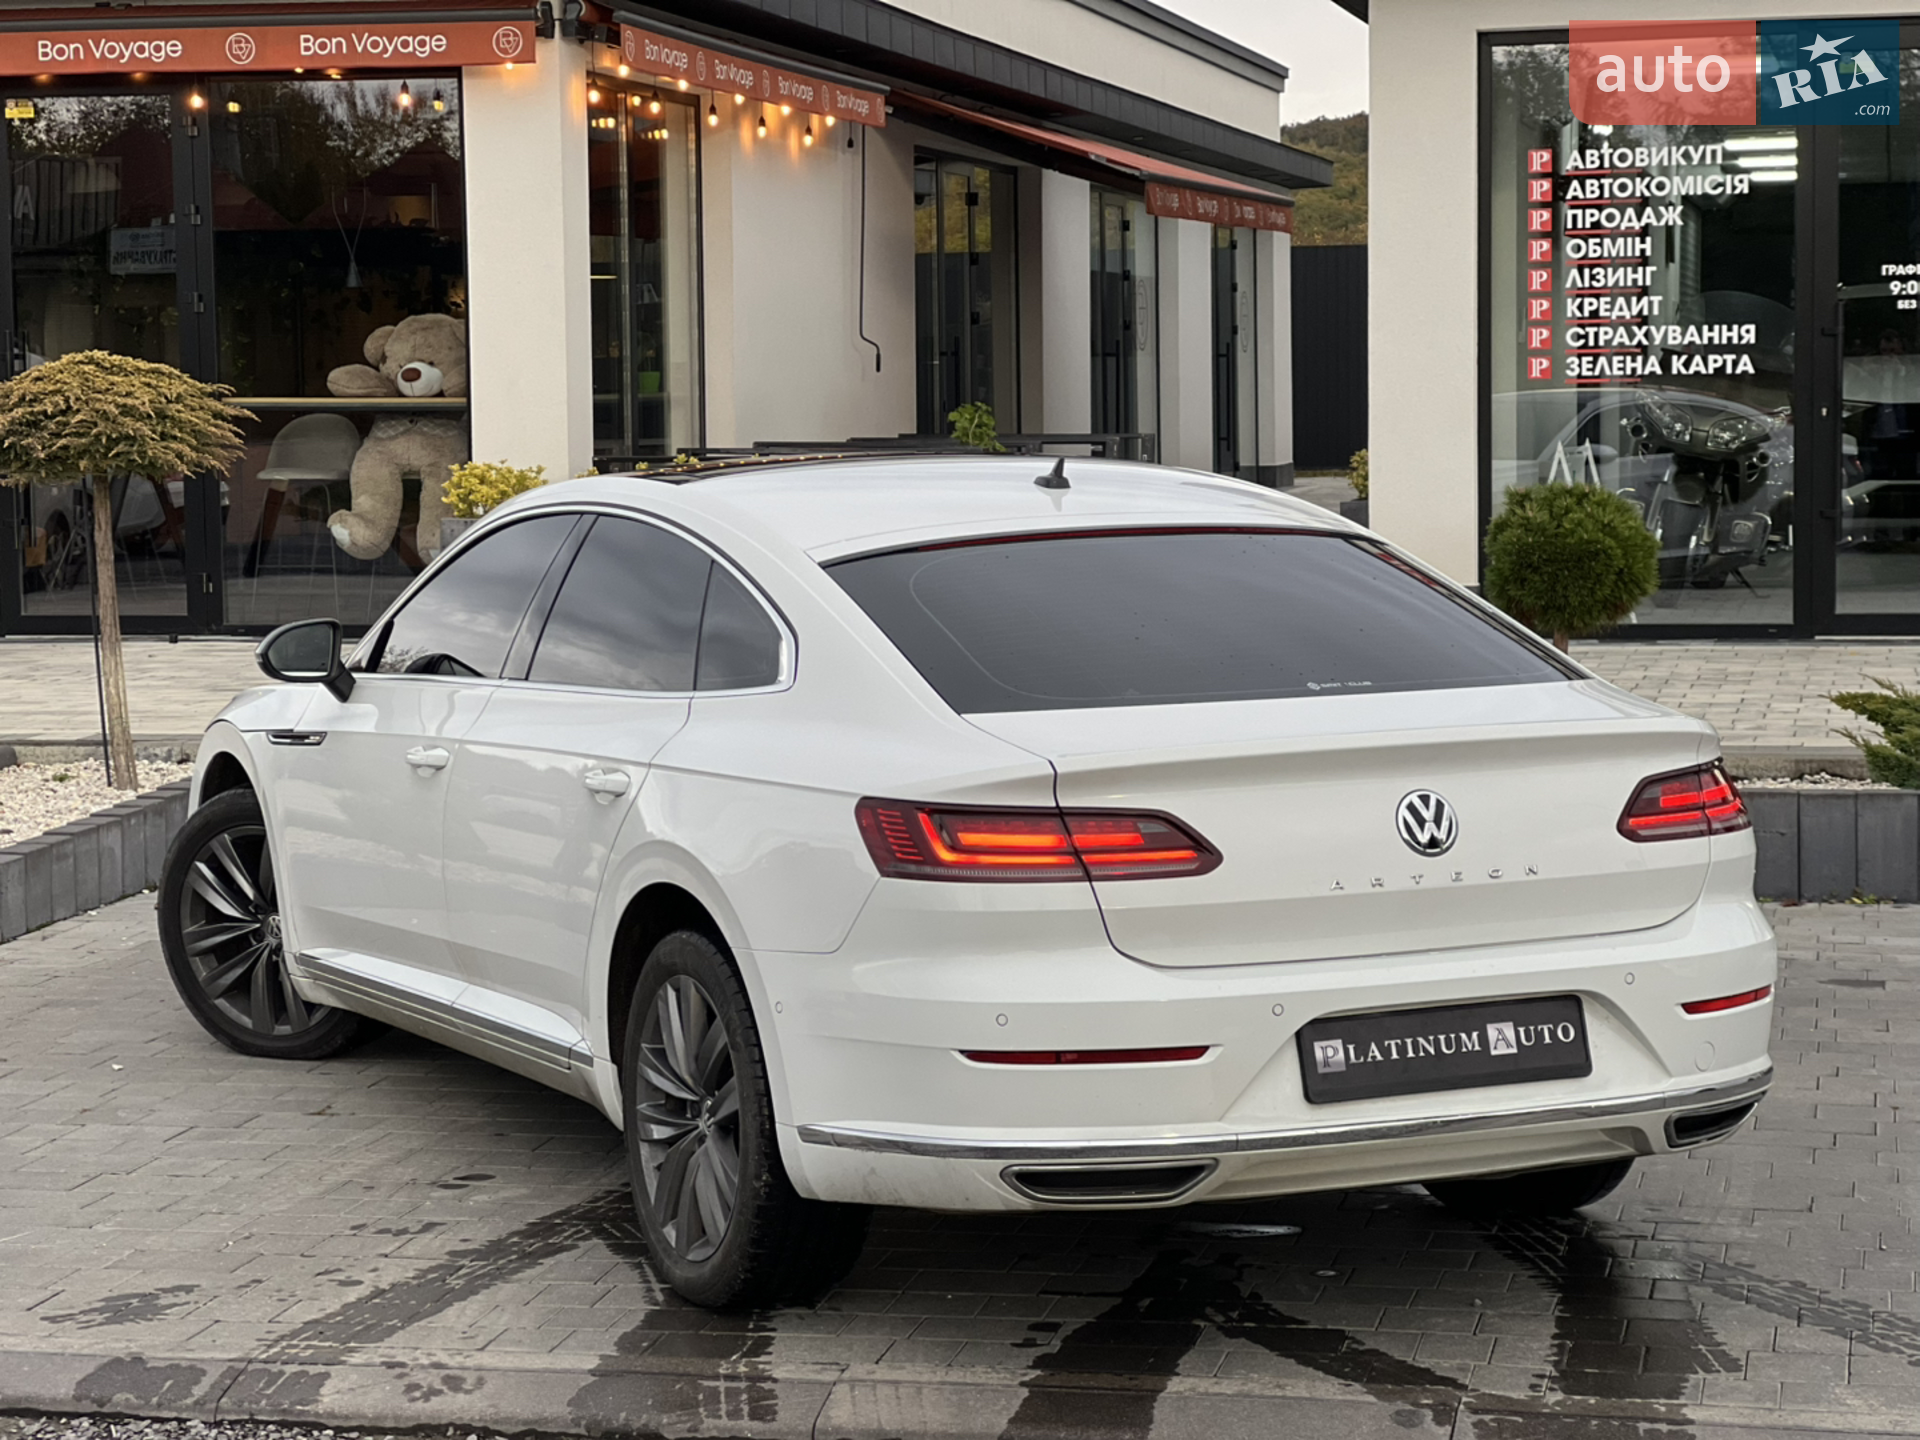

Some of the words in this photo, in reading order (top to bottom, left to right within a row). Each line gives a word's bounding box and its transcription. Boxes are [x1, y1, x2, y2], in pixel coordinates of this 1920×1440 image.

[37, 40, 84, 61] Bon
[88, 38, 182, 63] Voyage
[300, 34, 346, 56] Bon
[352, 33, 447, 58] Voyage
[644, 39, 659, 61] Bon
[659, 44, 688, 71] Voyage
[714, 59, 727, 80] Bon
[727, 63, 754, 89] Voyage
[778, 75, 790, 95] Bon
[1566, 145, 1723, 170] АВТОВИКУП
[1565, 174, 1749, 200] АВТОКОМІСІЯ
[1566, 205, 1684, 230] ПРОДАЖ
[1566, 237, 1652, 259] ОБМІН
[1565, 266, 1657, 288] ЛІЗИНГ
[1566, 296, 1663, 319] КРЕДИТ
[1897, 299, 1917, 309] БЕЗ
[1565, 324, 1756, 347] СТРАХУВАННЯ
[1565, 356, 1662, 376] ЗЕЛЕНА
[1671, 354, 1755, 375] КАРТА
[1330, 864, 1539, 891] ARTEON
[1316, 1031, 1482, 1071] PLATINUM
[1489, 1022, 1576, 1053] AUTO
